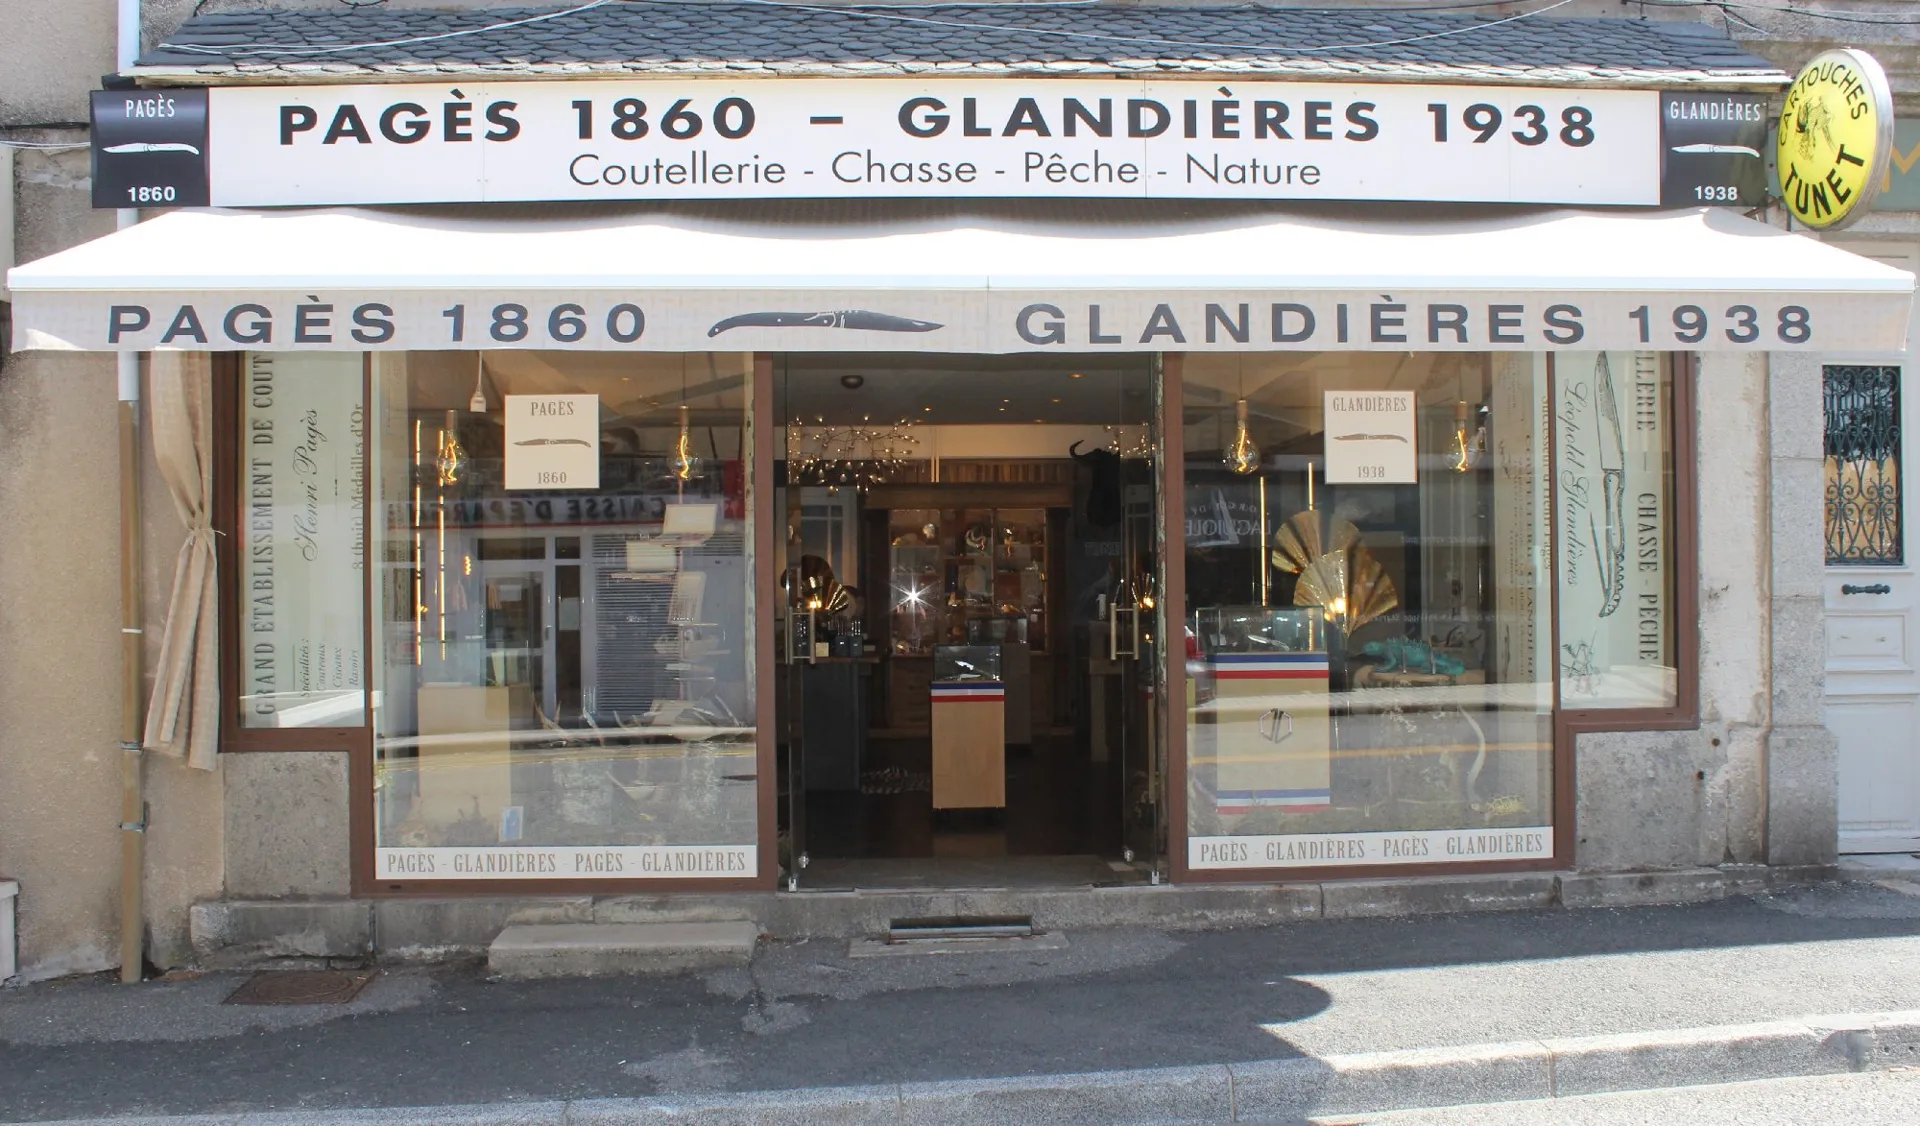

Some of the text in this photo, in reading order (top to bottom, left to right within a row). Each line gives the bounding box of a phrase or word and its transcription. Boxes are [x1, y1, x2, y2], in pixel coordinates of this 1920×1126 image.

[126, 96, 175, 118] PAGÈS
[280, 89, 521, 145] PAGÈS
[572, 98, 755, 141] 1860
[898, 86, 1378, 141] GLANDIÈRES
[1428, 103, 1595, 147] 1938
[1670, 99, 1760, 121] GLANDIÈRES
[1779, 62, 1868, 146] CARTOUCHES
[569, 150, 785, 186] Coutellerie
[832, 150, 976, 183] Chasse
[1025, 150, 1138, 184] Pêche
[1187, 153, 1320, 186] Nature
[1694, 185, 1738, 201] 1938
[1785, 144, 1865, 218] TUNET
[127, 186, 176, 202] 1860
[109, 295, 646, 344] PAGÈS 1860
[1016, 295, 1812, 346] GLANDIÈRES 1938
[253, 416, 274, 445] DE
[293, 408, 328, 562] Henri Pagès
[351, 440, 364, 511] Médailles
[537, 471, 567, 484] 1860
[1357, 466, 1385, 478] 1938
[1557, 378, 1590, 586] Léopold Glandières
[250, 458, 276, 633] ÉTABLISSEMENT
[1637, 493, 1657, 573] CHASSE
[1639, 594, 1661, 660] PÊCHE
[255, 643, 276, 715] GRAND
[388, 851, 436, 873] PAGÈS
[454, 850, 557, 873] GLANDIÈRES
[575, 850, 623, 872] PAGÈS
[642, 849, 746, 872] GLANDIÈRES
[1201, 840, 1248, 862] PAGÈS
[1266, 838, 1365, 860] GLANDIÈRES
[1383, 835, 1429, 857] PAGÈS
[1447, 832, 1543, 855] GLANDIÈRES
